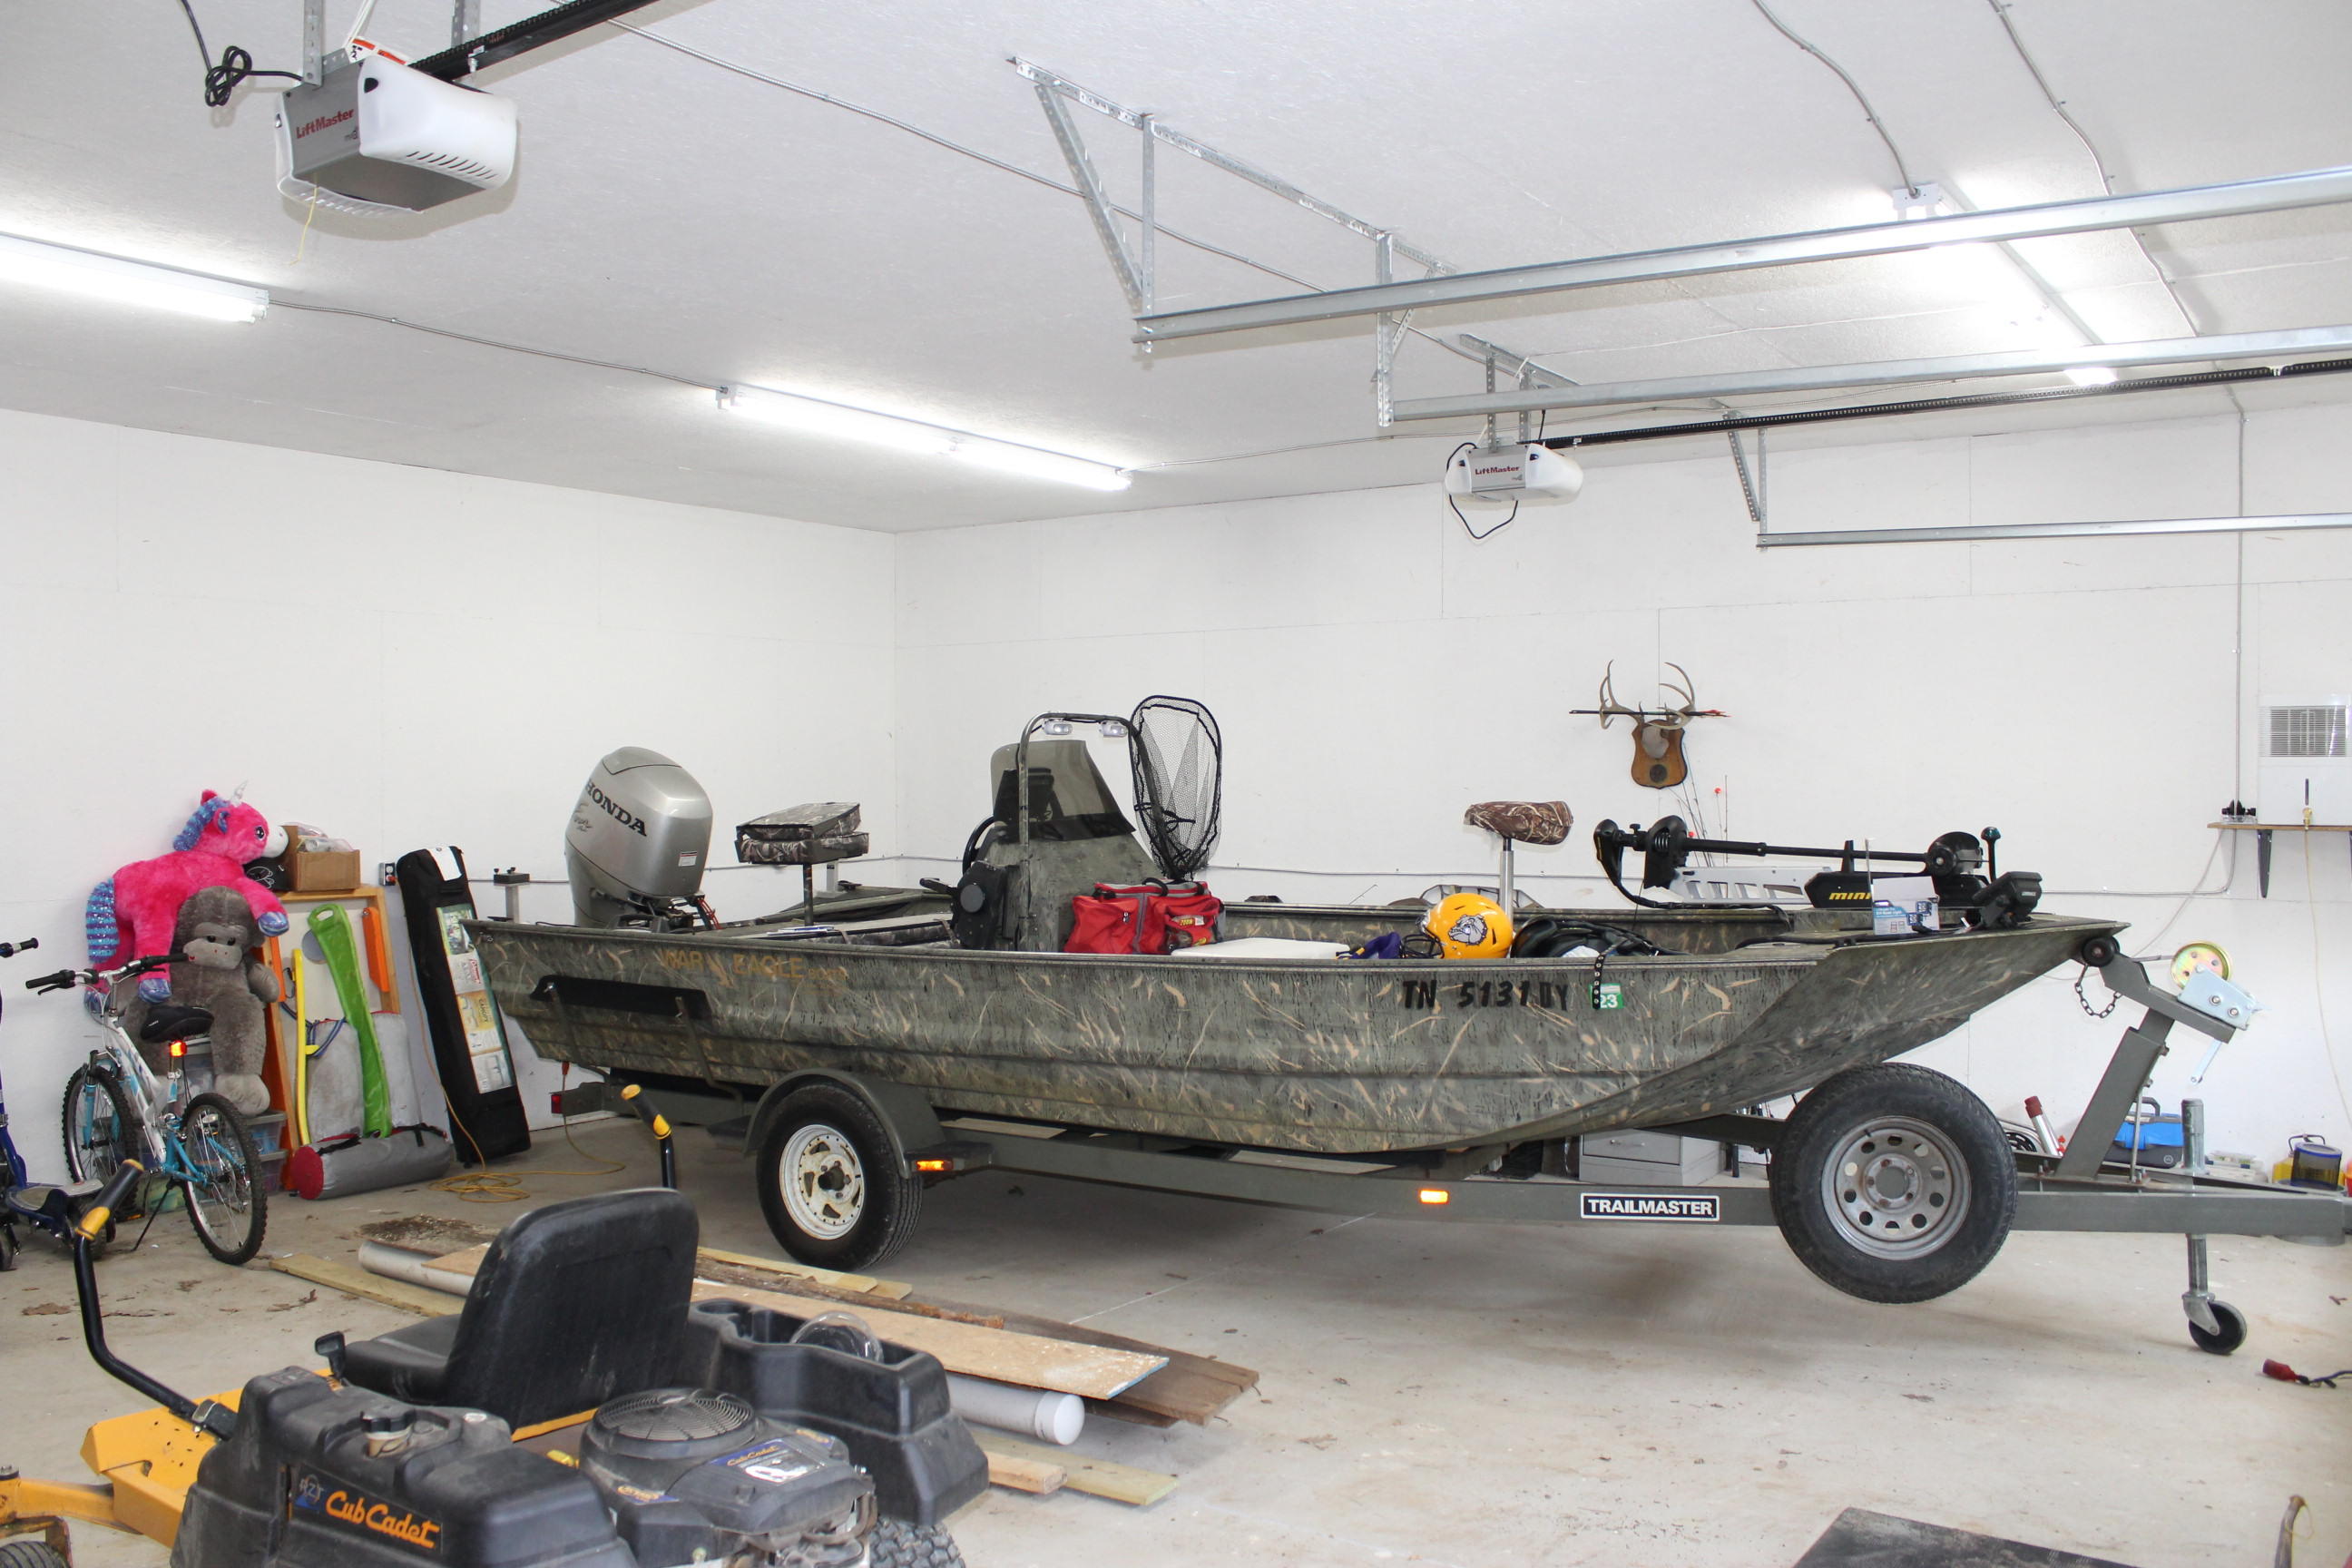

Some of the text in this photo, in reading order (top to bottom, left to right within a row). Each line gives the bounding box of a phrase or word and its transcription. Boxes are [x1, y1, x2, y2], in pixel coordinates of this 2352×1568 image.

[296, 109, 354, 139] LiftMaster
[1475, 466, 1520, 475] LiftMaster
[585, 779, 647, 837] HONDA
[660, 950, 704, 974] WAR
[732, 954, 805, 979] EAGLE
[1403, 979, 1437, 1009] TN
[1457, 980, 1530, 1008] 5131
[1600, 994, 1618, 1009] 23
[1588, 1199, 1713, 1216] TRAILMASTER
